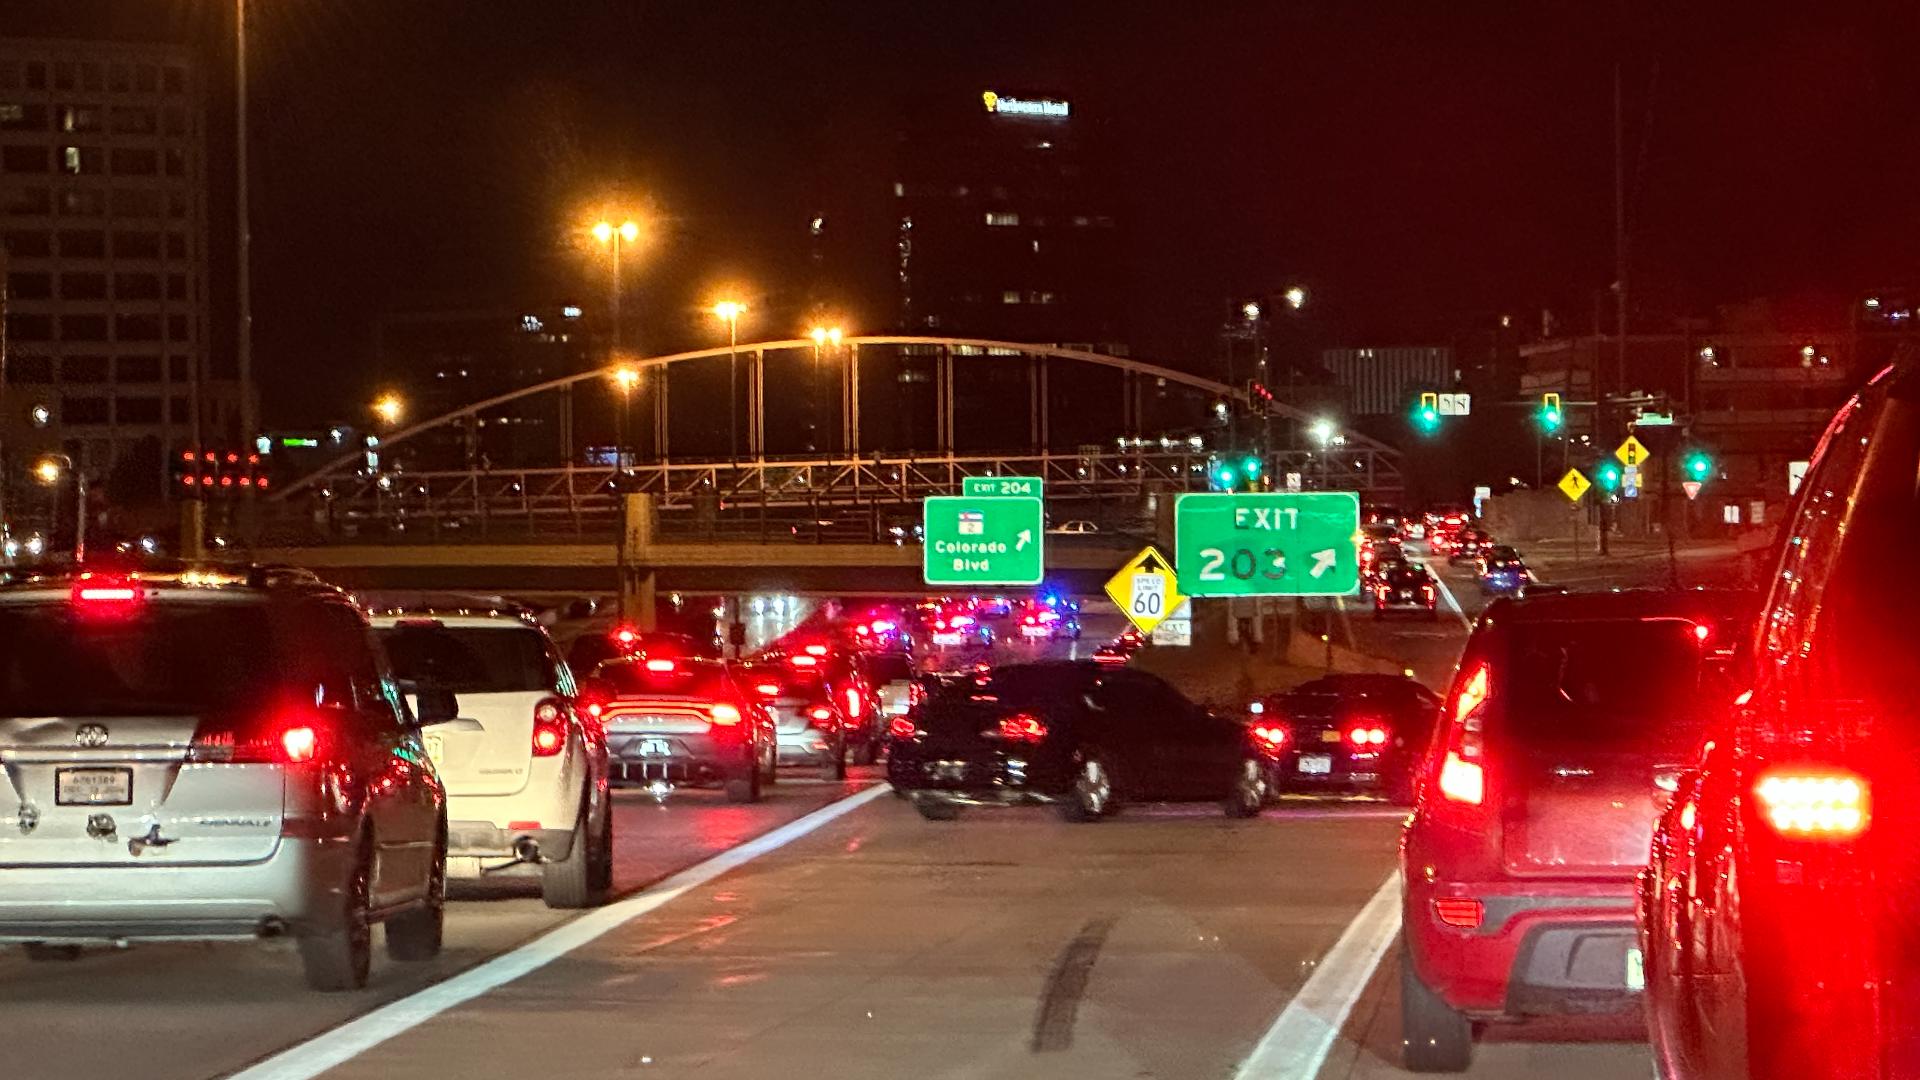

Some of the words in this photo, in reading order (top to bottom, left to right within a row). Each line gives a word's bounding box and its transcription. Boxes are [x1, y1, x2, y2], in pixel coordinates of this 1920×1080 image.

[1000, 481, 1031, 494] 204
[1235, 507, 1300, 530] EXIT
[935, 540, 1007, 553] Colorado
[953, 558, 990, 572] Blvd
[1199, 547, 1288, 581] 203
[1134, 592, 1160, 615] 60
